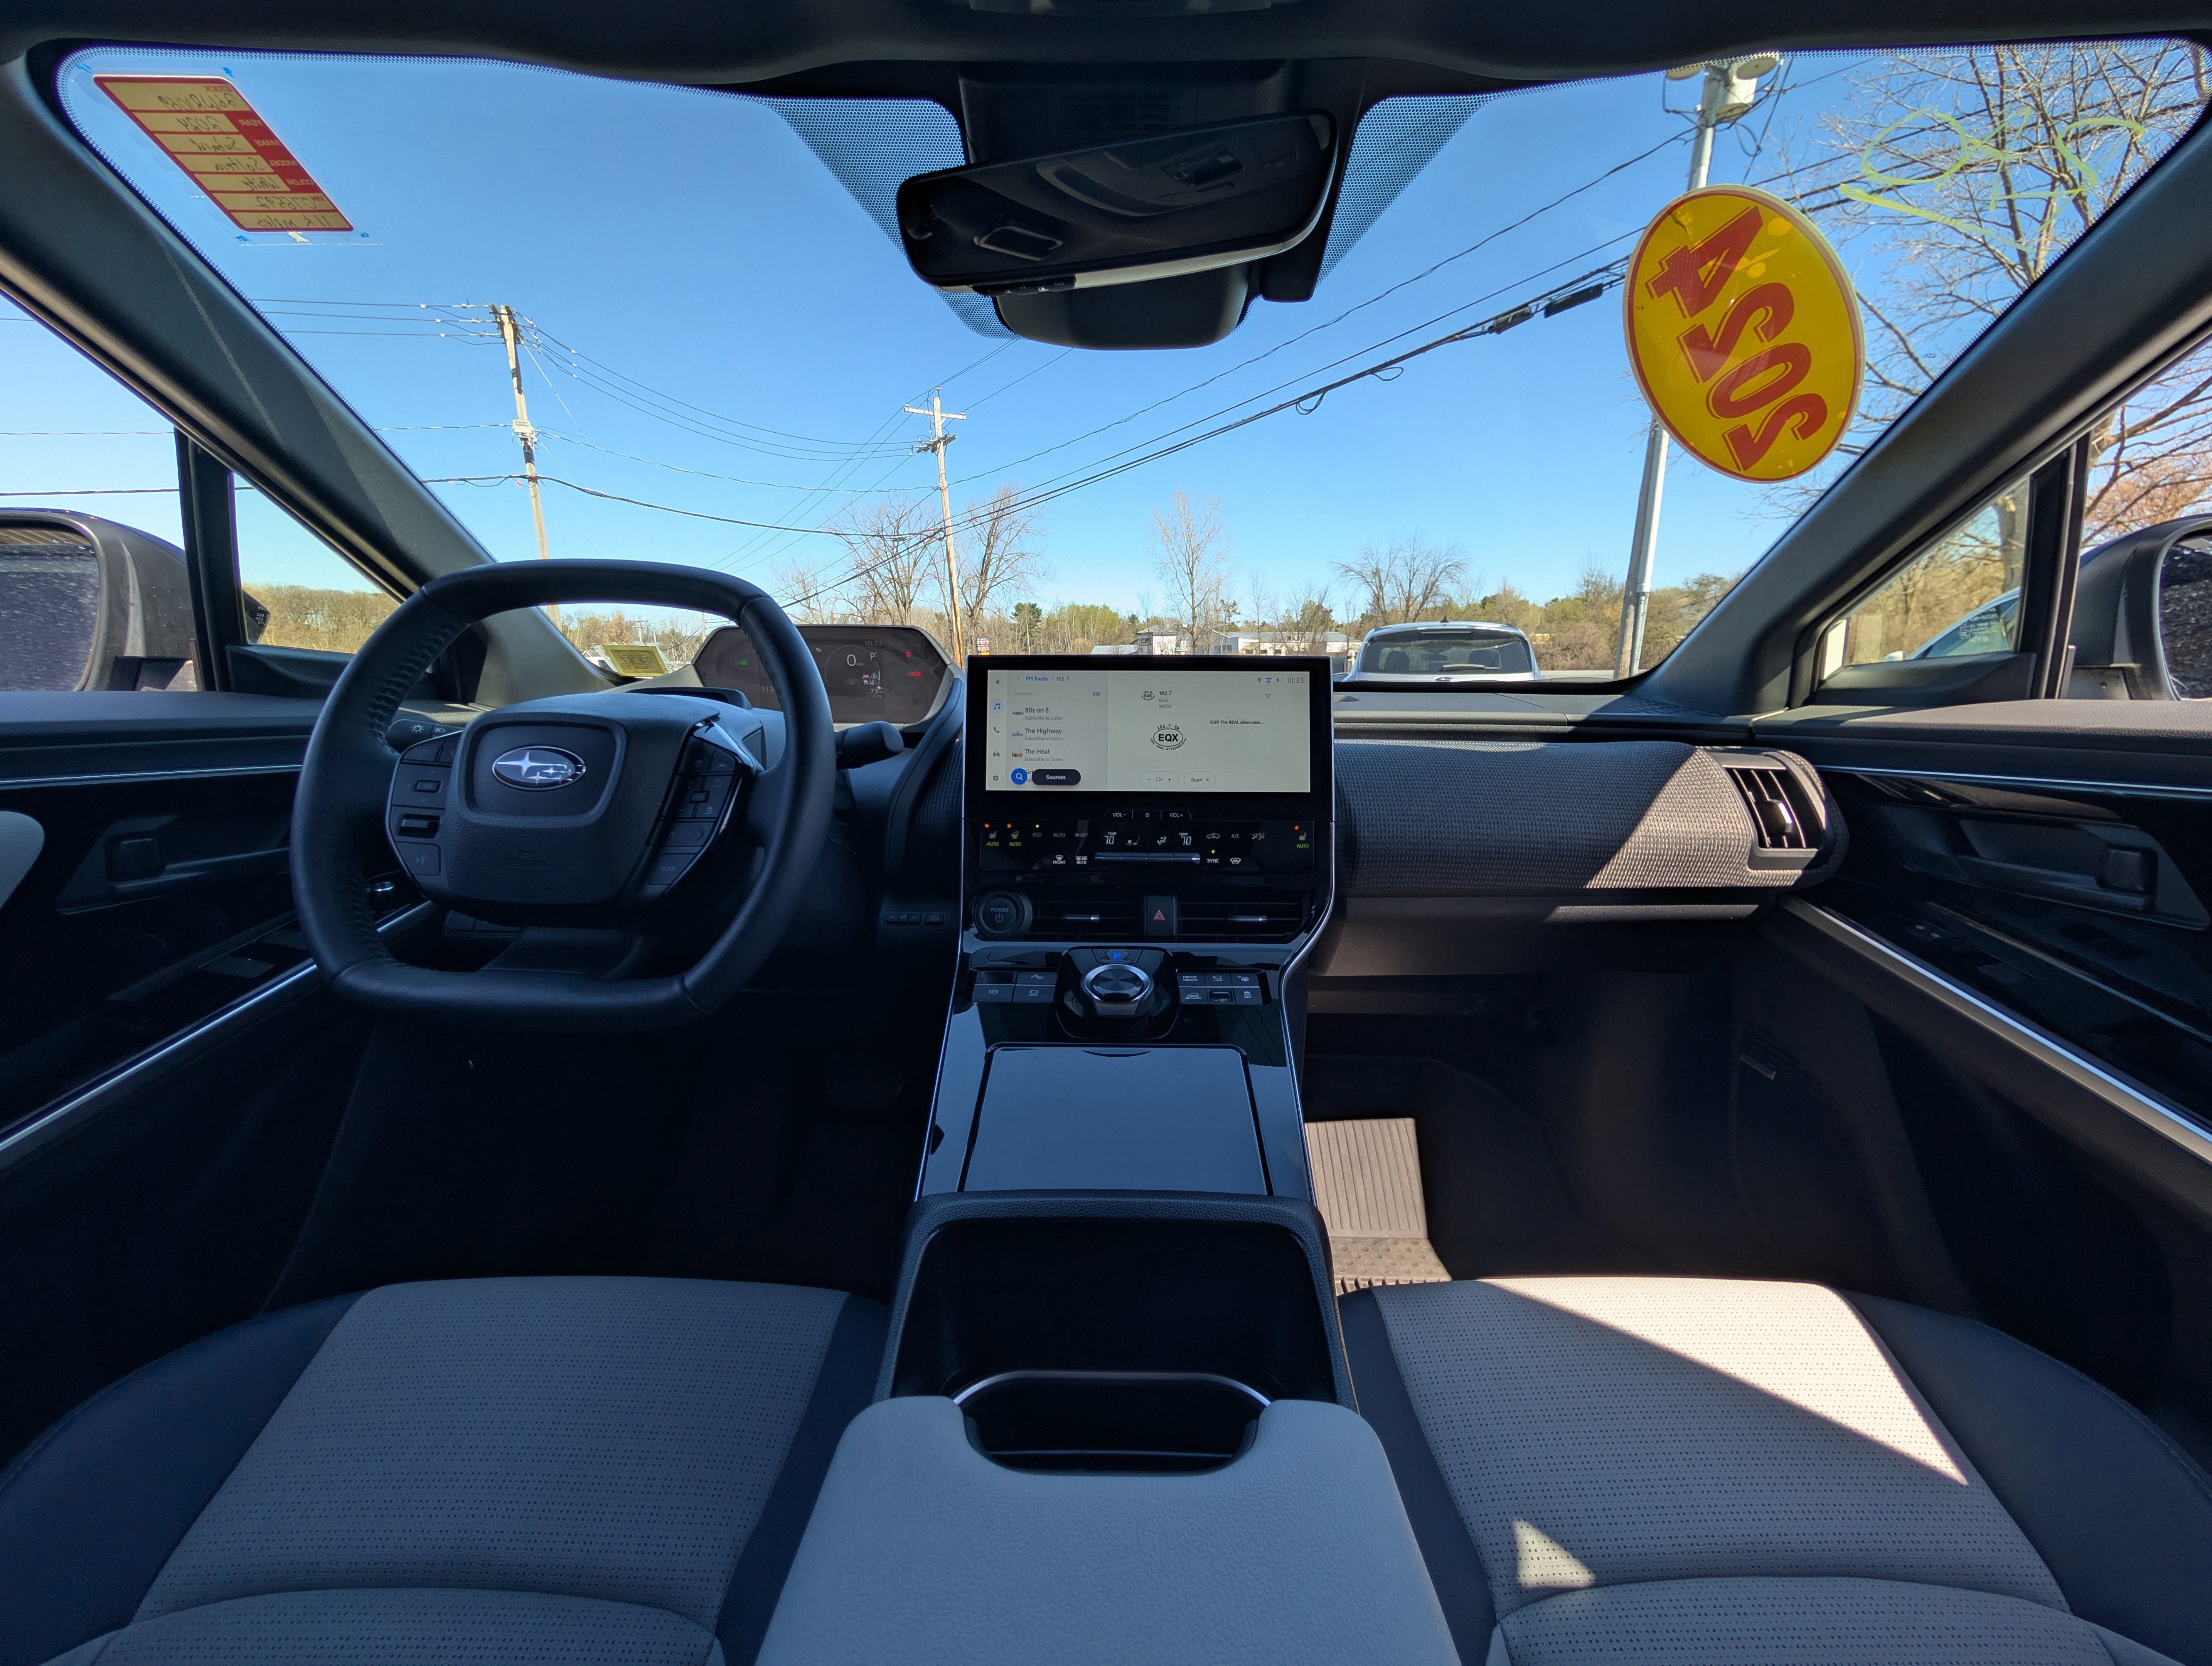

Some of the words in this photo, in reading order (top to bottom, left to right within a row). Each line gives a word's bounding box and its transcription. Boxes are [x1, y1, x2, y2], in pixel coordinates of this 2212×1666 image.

[847, 654, 856, 666] 0
[1158, 734, 1179, 742] EQX
[1104, 836, 1115, 845] 70
[1181, 836, 1192, 845] 70
